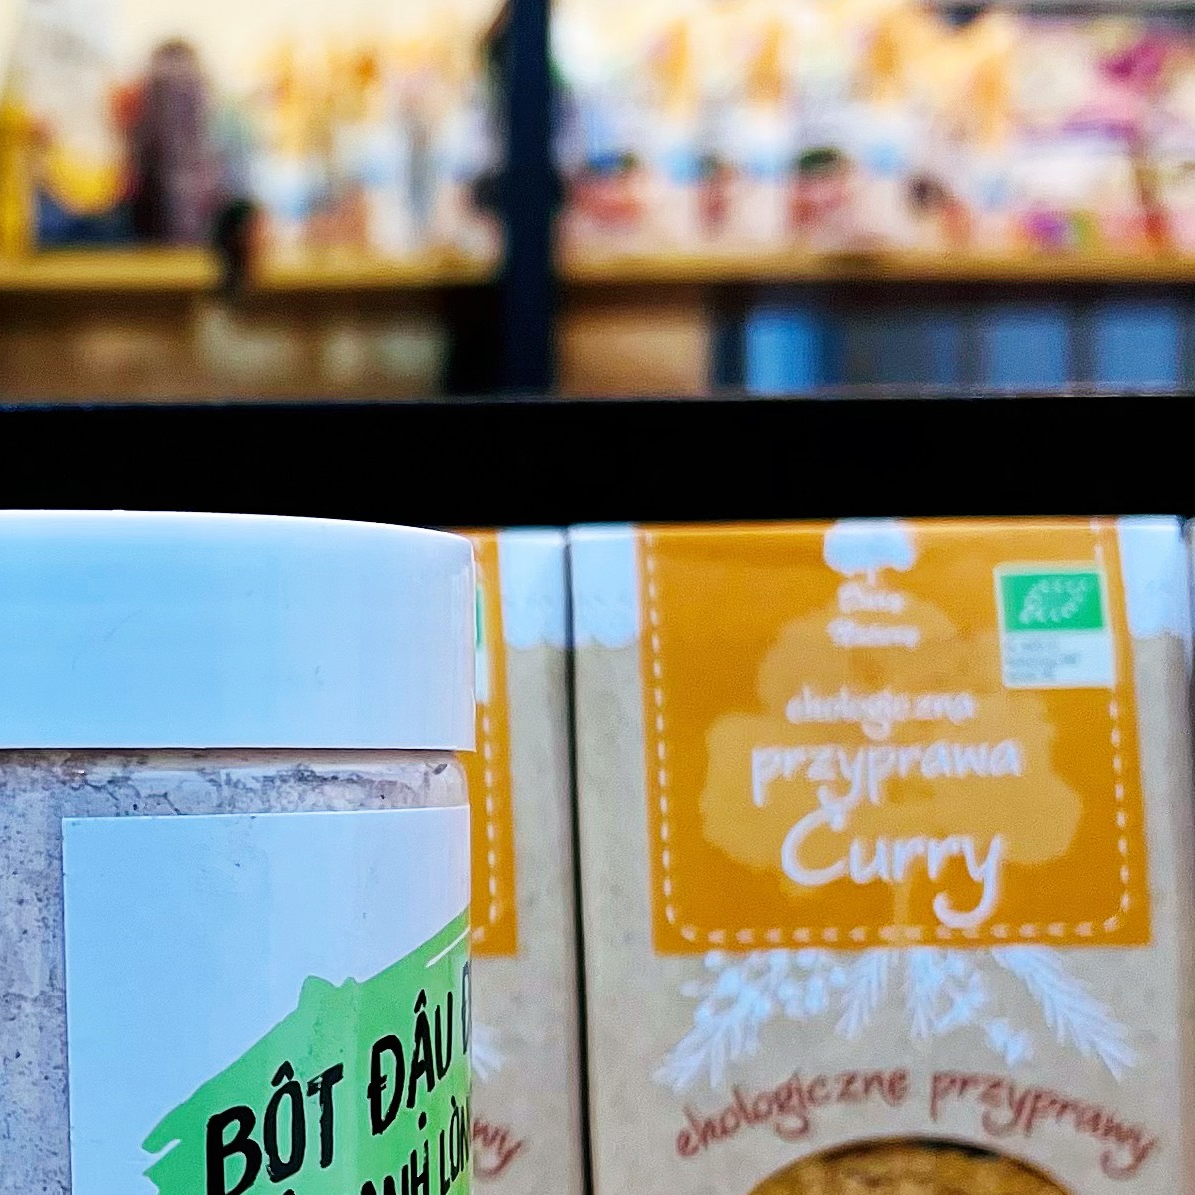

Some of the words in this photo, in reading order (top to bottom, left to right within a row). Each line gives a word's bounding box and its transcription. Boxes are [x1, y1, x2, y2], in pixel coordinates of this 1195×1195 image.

[751, 740, 1022, 808] przyprawa
[780, 806, 1005, 929] Curry
[367, 988, 455, 1136] ĐẬU
